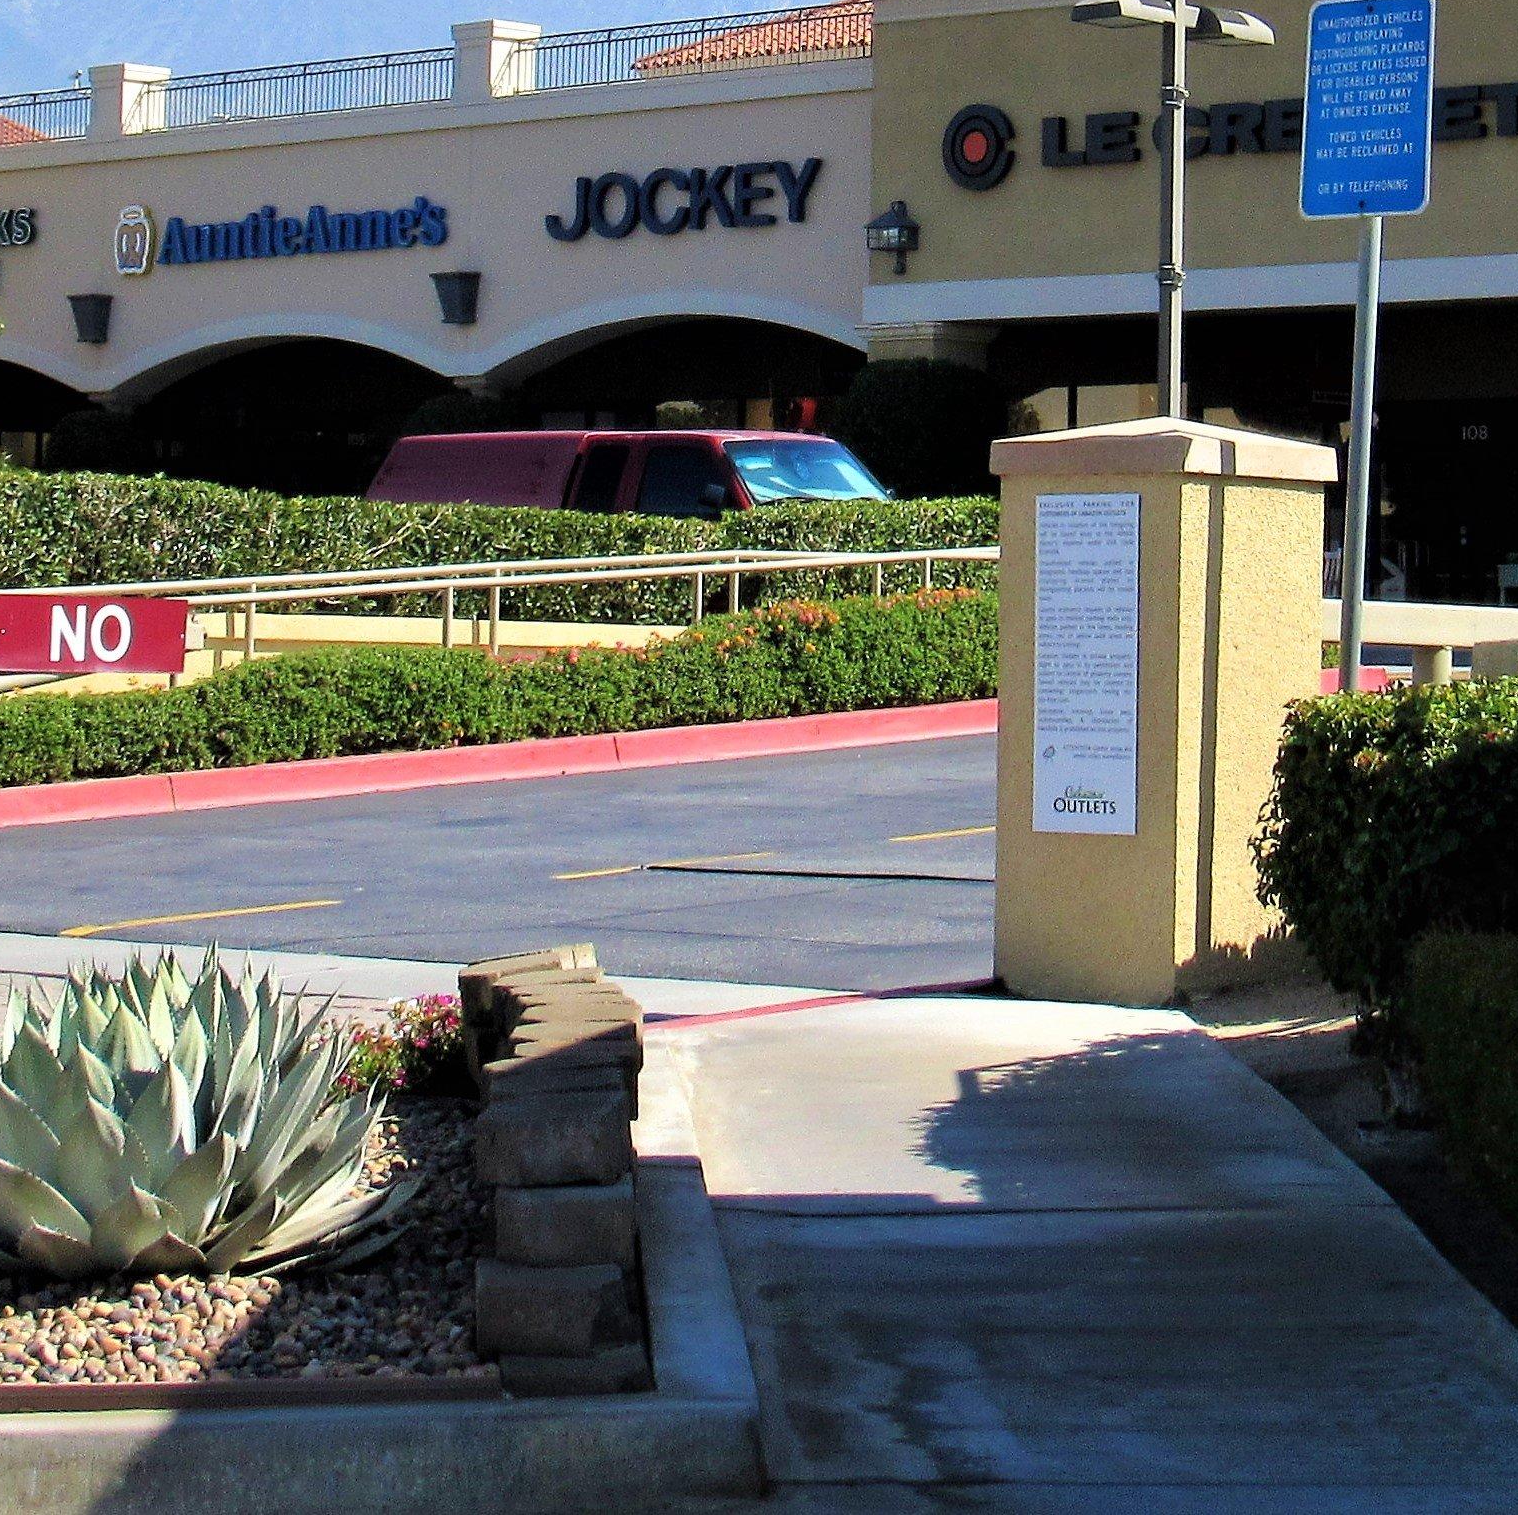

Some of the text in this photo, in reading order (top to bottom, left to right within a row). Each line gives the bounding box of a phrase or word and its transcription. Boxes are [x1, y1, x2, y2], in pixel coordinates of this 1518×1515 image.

[1317, 10, 1423, 31] UNAUTHORIZED VEHICLES
[1335, 27, 1403, 45] NOT DISPLAYING
[1313, 40, 1425, 61] DISTINGUISHING PLACARDS
[1311, 55, 1427, 76] OR LICENSE PLATES ISSUED
[1317, 70, 1419, 90] FOR DISABLED PERSONS
[1322, 86, 1413, 104] WILL BE TOWED AWAY
[1321, 106, 1330, 120] AT
[1371, 101, 1411, 116] EXPENSE
[1042, 111, 1142, 168] LE
[1328, 127, 1402, 144] TOWED VEHICLES
[1316, 142, 1414, 160] MAY BE RECLAIMED AT
[1318, 179, 1409, 195] OR BY TELEPHONING
[545, 157, 823, 242] JOCKEY
[1461, 424, 1489, 441] 108
[49, 604, 132, 663] NO
[1053, 797, 1117, 815] OUTLETS
